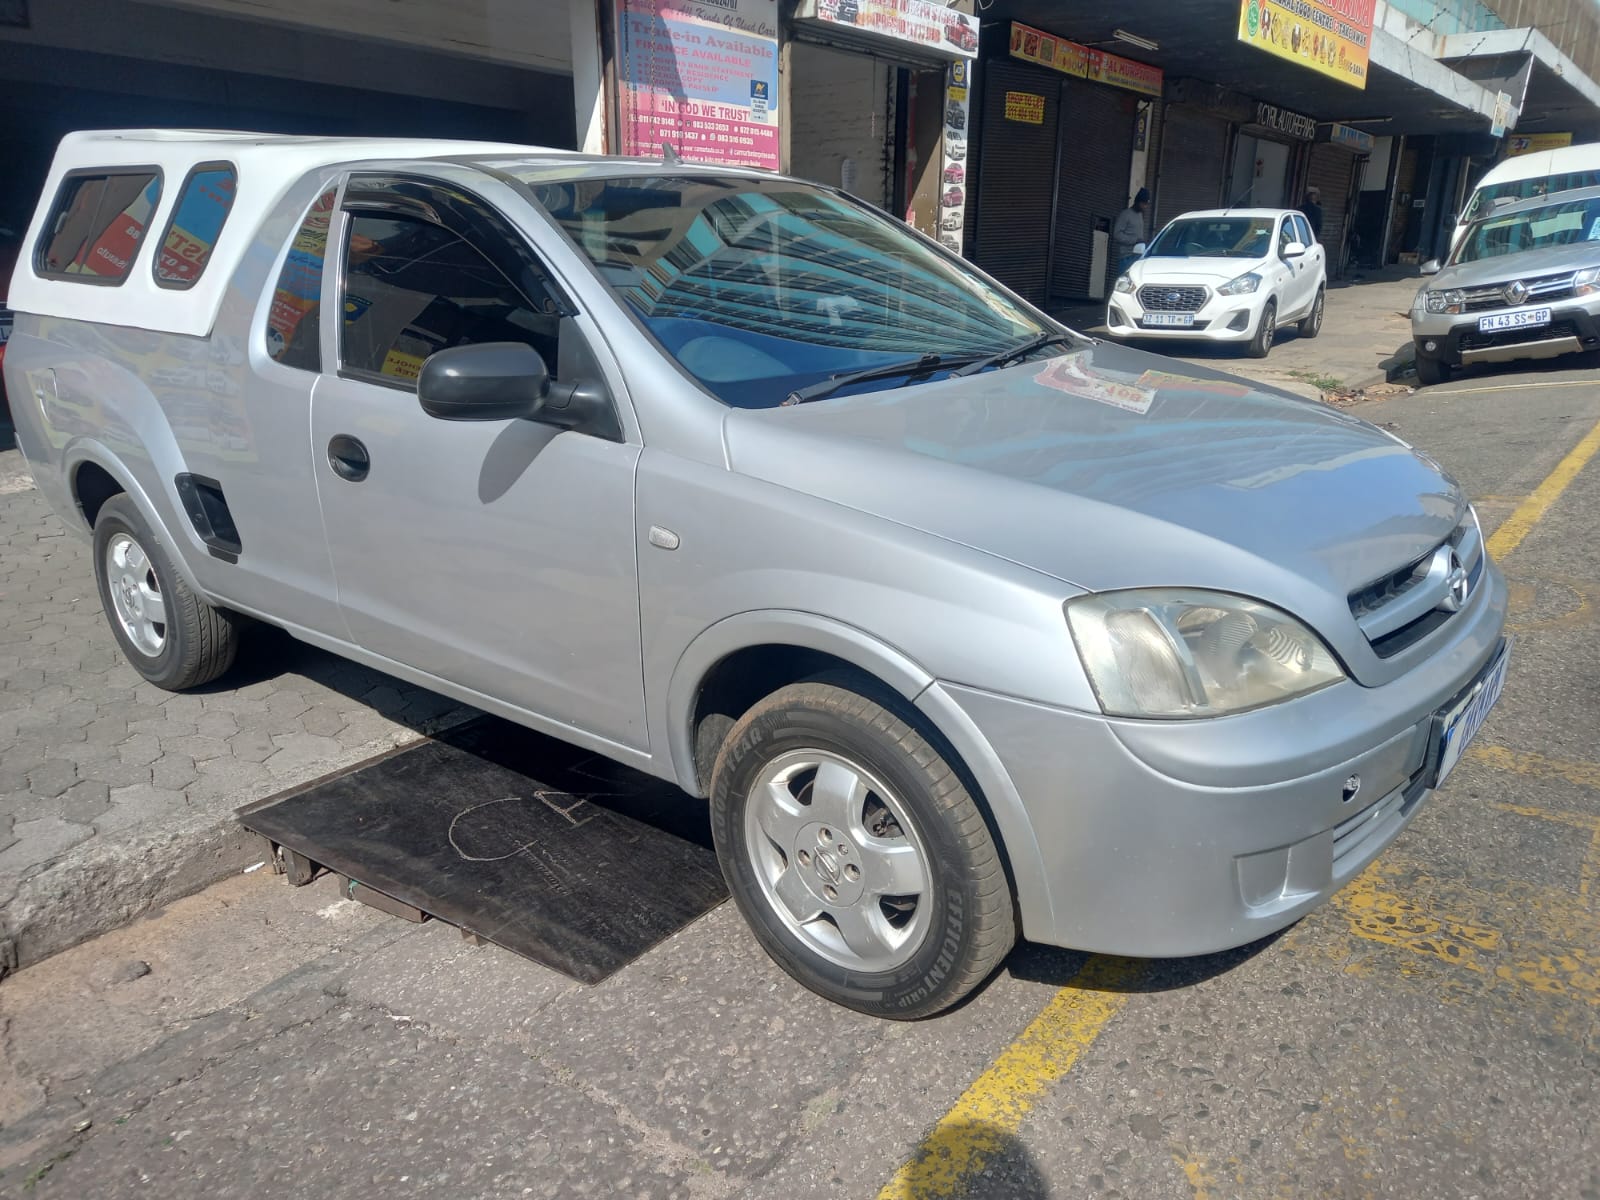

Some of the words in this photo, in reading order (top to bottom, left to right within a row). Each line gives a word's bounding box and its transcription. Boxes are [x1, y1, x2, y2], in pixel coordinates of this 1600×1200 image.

[696, 7, 720, 23] Kinds
[1312, 8, 1333, 31] CENTRE
[631, 21, 701, 44] Trade-in
[705, 35, 773, 58] Available
[635, 39, 689, 56] FINANCE
[691, 48, 752, 68] AVAILABLE
[711, 66, 755, 79] STATEMENT
[678, 101, 699, 115] GOD
[701, 103, 716, 118] WE
[1183, 315, 1194, 325] GP
[1481, 318, 1494, 329] FN
[1498, 315, 1510, 326] 43
[1514, 313, 1527, 325] SS
[1535, 310, 1548, 322] GP
